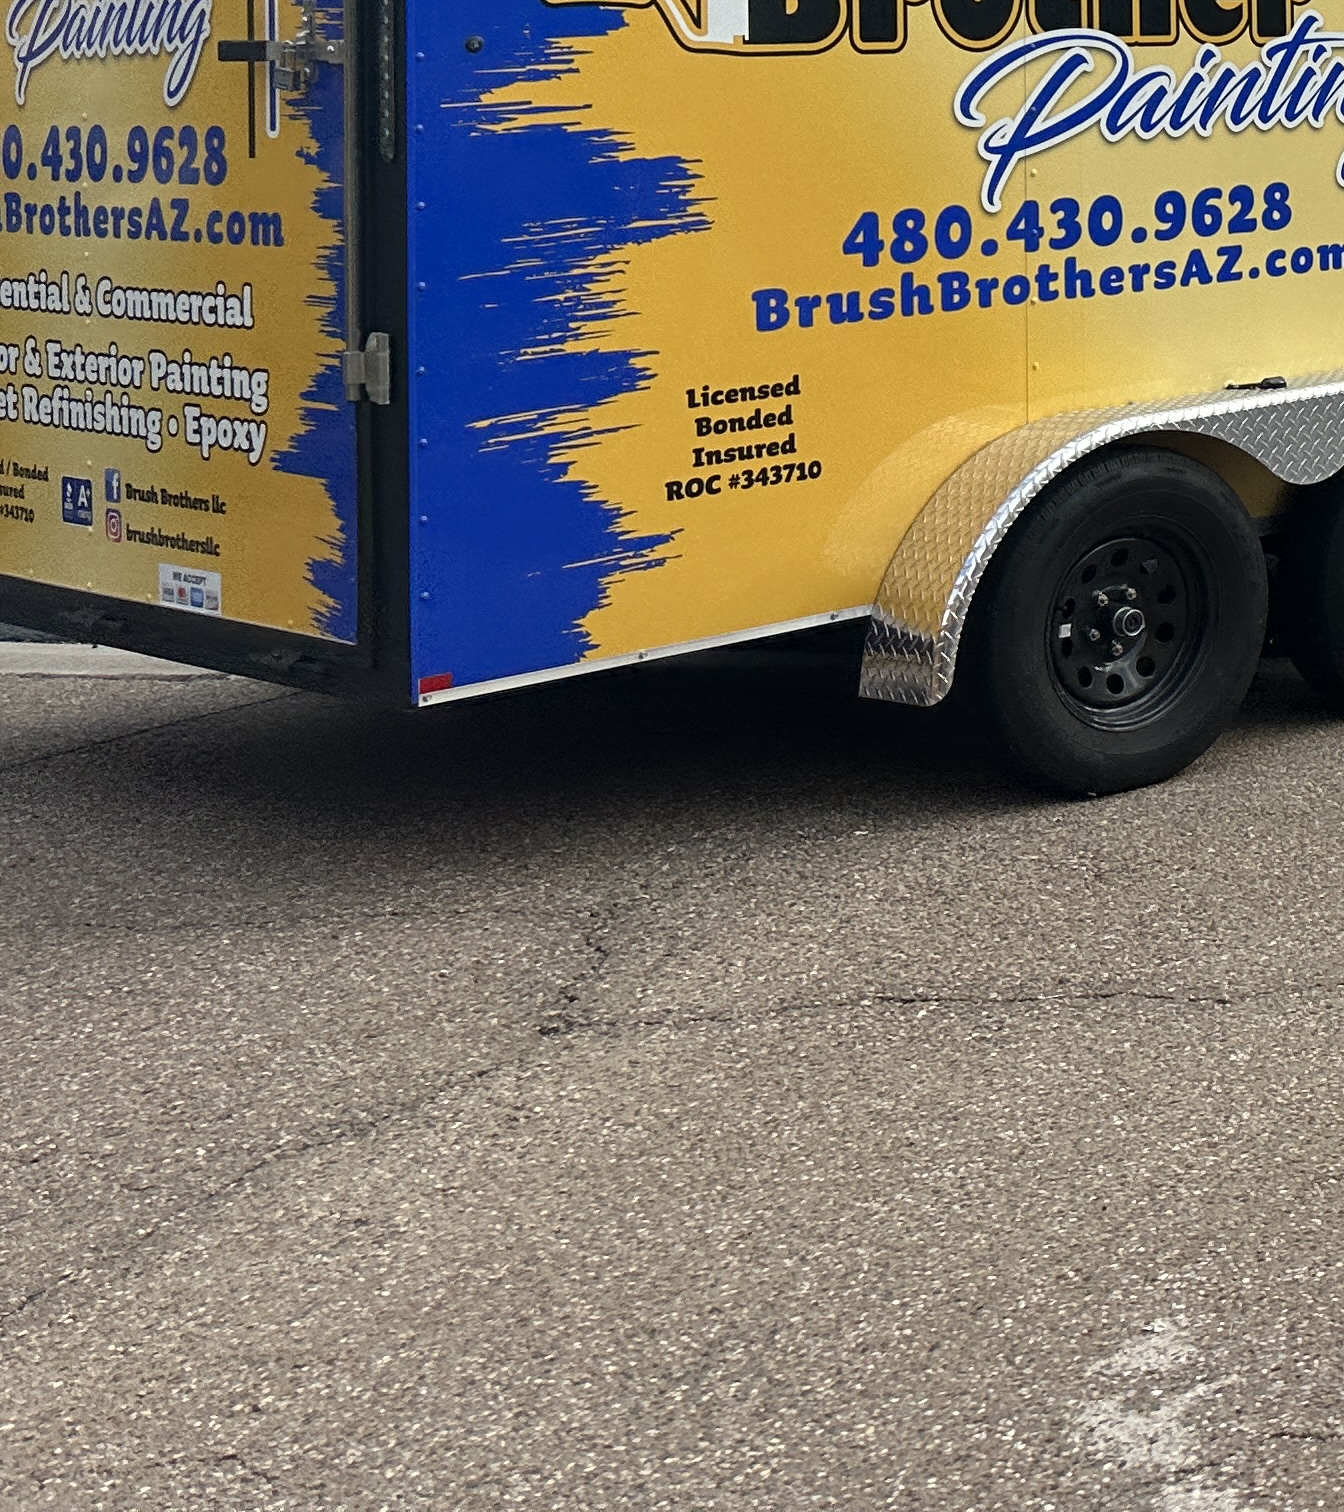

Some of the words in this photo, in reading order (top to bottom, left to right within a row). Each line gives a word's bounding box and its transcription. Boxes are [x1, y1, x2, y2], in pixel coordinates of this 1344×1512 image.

[842, 182, 1293, 268] 480.430.9628
[74, 273, 93, 317] &
[96, 276, 255, 329] Commercial
[23, 335, 42, 378] &
[45, 340, 144, 388] Exterior
[148, 349, 269, 415] Painting
[686, 374, 801, 408] Licensed
[22, 384, 162, 453] Refinishing
[182, 403, 268, 466] Epoxy
[694, 404, 793, 437] Bonded
[692, 433, 797, 467] Insured
[13, 461, 49, 482] Bonded
[665, 474, 722, 501] ROC
[728, 460, 822, 489] #343710
[125, 483, 158, 505] Brush
[161, 488, 210, 512] Brothers
[212, 494, 226, 515] llc
[126, 523, 220, 557] brushbrothersllc
